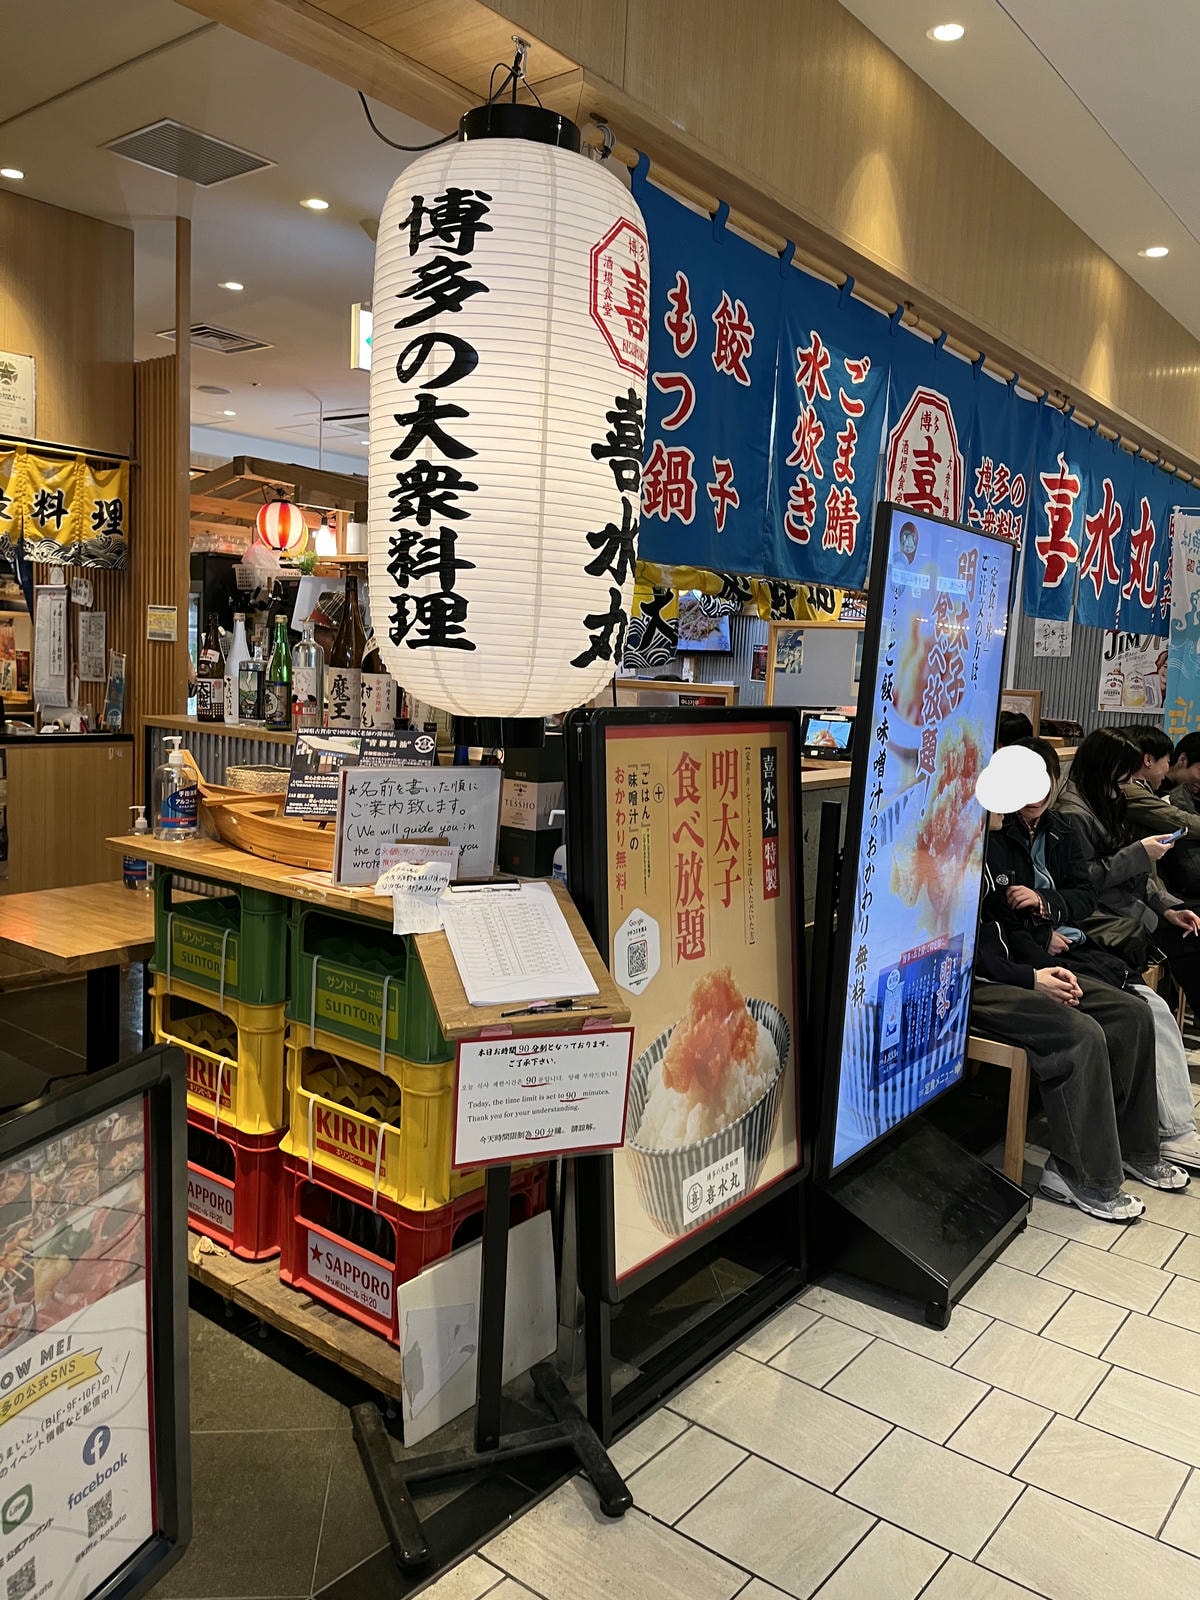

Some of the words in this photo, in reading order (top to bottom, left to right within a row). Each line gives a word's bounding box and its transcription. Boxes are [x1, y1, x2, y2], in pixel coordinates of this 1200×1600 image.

[603, 254, 614, 317] 酒場食堂
[614, 260, 648, 342] 喜
[388, 187, 494, 651] 博多の大衆料理
[641, 270, 698, 526] もつ鍋
[706, 289, 755, 534] 餃子
[784, 330, 832, 545] 水炊き
[919, 410, 940, 435] 博多
[822, 355, 871, 556] ごま鯖
[902, 435, 943, 516] 喜
[974, 456, 1027, 507] 博多の
[570, 387, 643, 668] 喜水丸
[1035, 451, 1160, 610] 喜水丸
[330, 674, 351, 721] 魔王
[350, 797, 467, 818] ご案内致します。
[504, 799, 536, 810] TESSHO
[346, 823, 376, 841] (We
[380, 823, 399, 836] will
[402, 821, 434, 840] guide
[439, 824, 459, 838] you
[463, 822, 476, 831] in
[353, 846, 373, 856] the
[459, 843, 479, 858] you
[711, 748, 742, 908] 明太子
[352, 857, 380, 869] wrote
[671, 751, 706, 965] 食べ放題
[181, 927, 212, 947] サントリー
[181, 950, 227, 974] SUNTOR
[326, 975, 365, 994] サントリー
[186, 1052, 231, 1097] IRIN
[526, 1076, 537, 1084] 90
[467, 1113, 489, 1123] Thank
[490, 1111, 503, 1120] you
[504, 1110, 514, 1118] for
[515, 1109, 530, 1118] your
[531, 1104, 580, 1115] understanding.
[468, 1100, 491, 1109] Today,
[492, 1098, 504, 1106] the
[505, 1096, 520, 1105] time
[521, 1094, 537, 1103] limit
[539, 1093, 545, 1101] is
[565, 1091, 577, 1100] 90
[582, 1089, 610, 1097] minutes.
[316, 1106, 386, 1162] KIRIN
[335, 1148, 364, 1166] キリンビール
[187, 1180, 233, 1217] APPORO
[705, 1171, 741, 1206] 喜水丸
[325, 1251, 390, 1301] SAPPORO
[325, 1274, 360, 1299] サッポロビール
[360, 1293, 377, 1310] 中20
[67, 1452, 128, 1510] facebook
